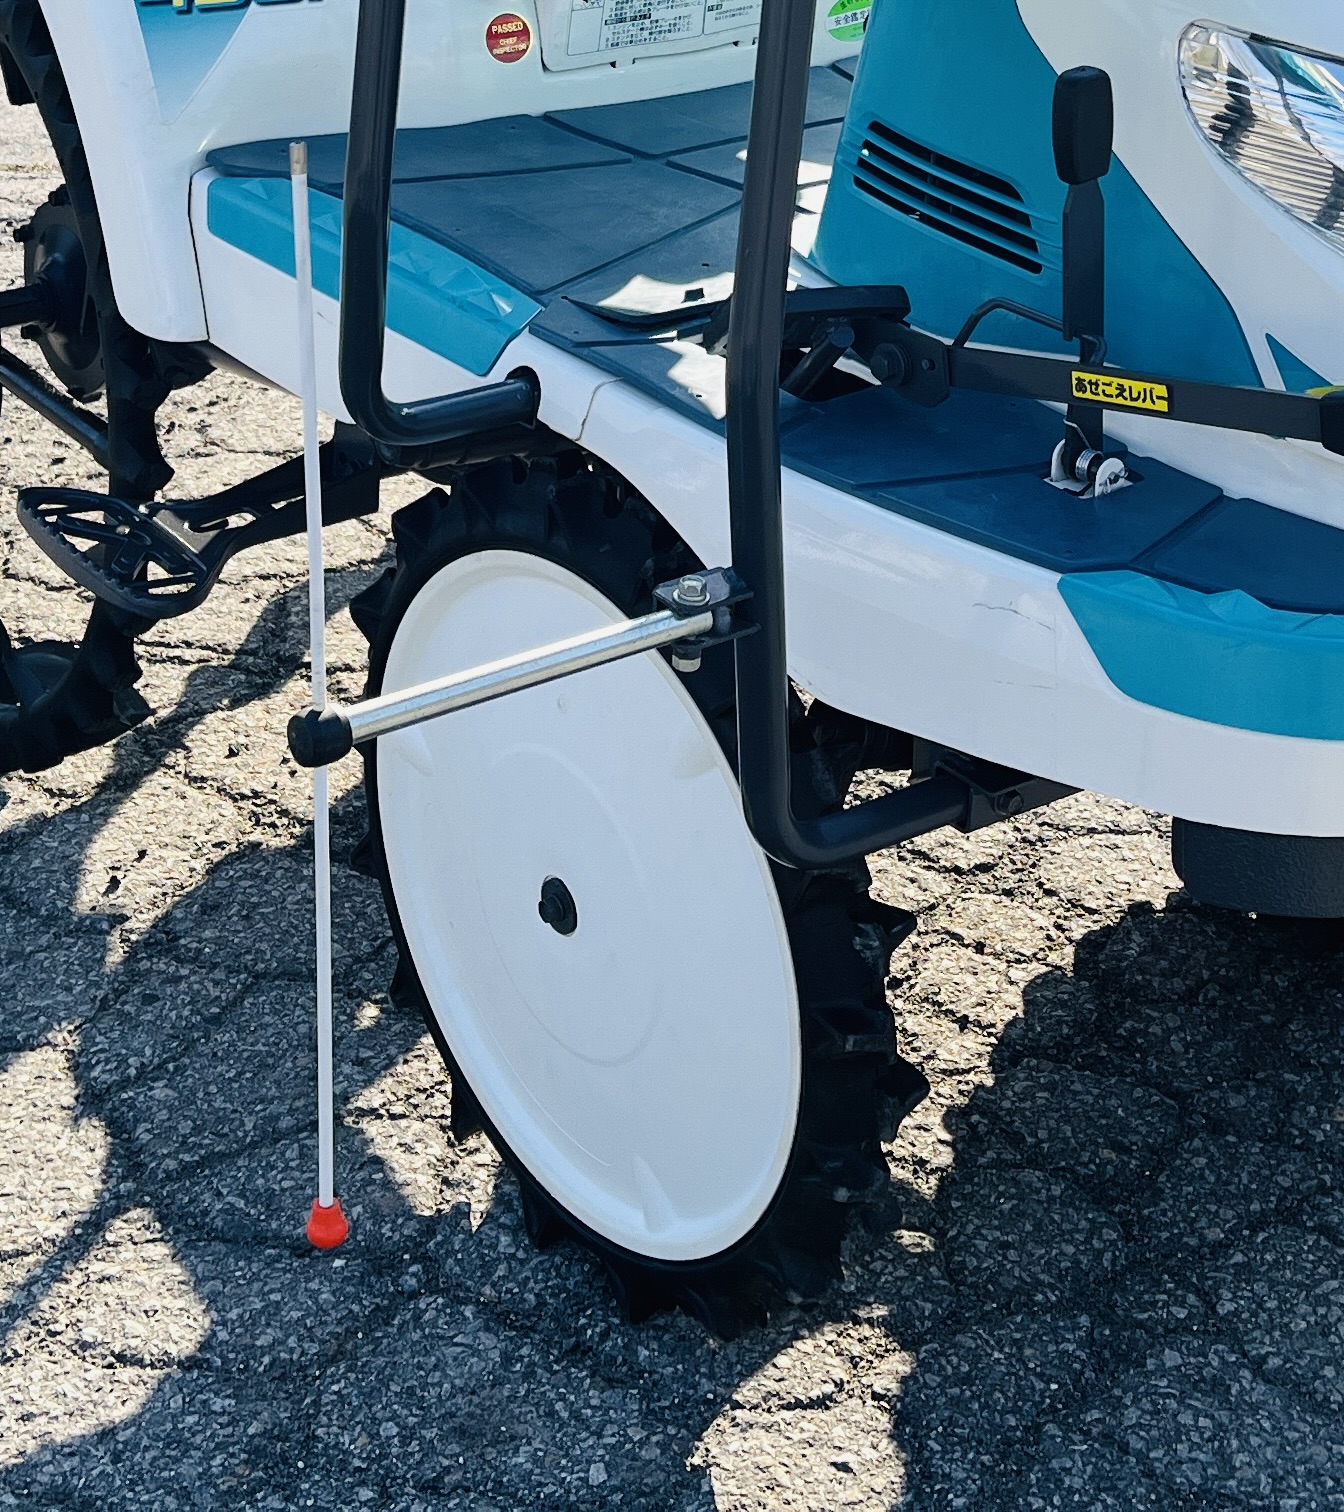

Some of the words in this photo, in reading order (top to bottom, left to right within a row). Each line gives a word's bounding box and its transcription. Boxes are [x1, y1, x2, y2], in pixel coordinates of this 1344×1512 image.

[834, 10, 870, 27] 安全鑑定
[491, 21, 524, 35] PASSED
[1074, 374, 1168, 408] あぜごえレバー
